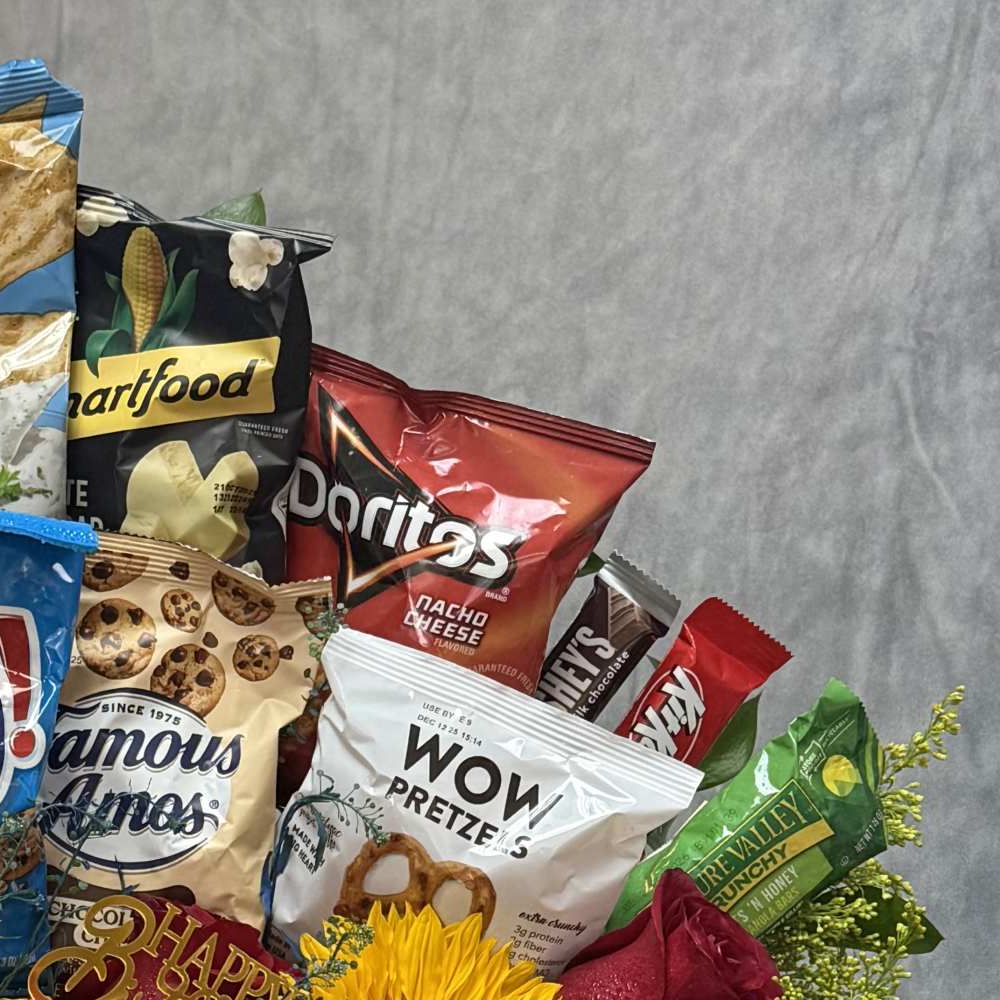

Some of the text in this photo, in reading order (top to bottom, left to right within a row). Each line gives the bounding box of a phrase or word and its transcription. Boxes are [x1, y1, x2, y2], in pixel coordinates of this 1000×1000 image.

[69, 358, 259, 419] artfood
[289, 456, 523, 579] Doritos
[403, 611, 484, 645] CHEESE
[416, 594, 489, 627] NACHO
[434, 637, 476, 656] FLAVORED
[537, 626, 616, 713] HEY'S
[588, 650, 630, 704] chocolate
[101, 702, 182, 726] SINCE 1975
[417, 714, 436, 726] DEC
[422, 702, 441, 716] USE
[442, 708, 455, 719] BY
[49, 727, 245, 777] amous
[404, 723, 564, 830] WOW
[292, 824, 312, 848] MADE
[385, 776, 531, 859] PRETZES
[696, 853, 735, 896] URE
[727, 791, 807, 862] VALLEY
[709, 843, 788, 908] RUNCHY
[761, 866, 800, 903] HONEY
[514, 924, 564, 945] 3g protein
[523, 940, 547, 953] fiber
